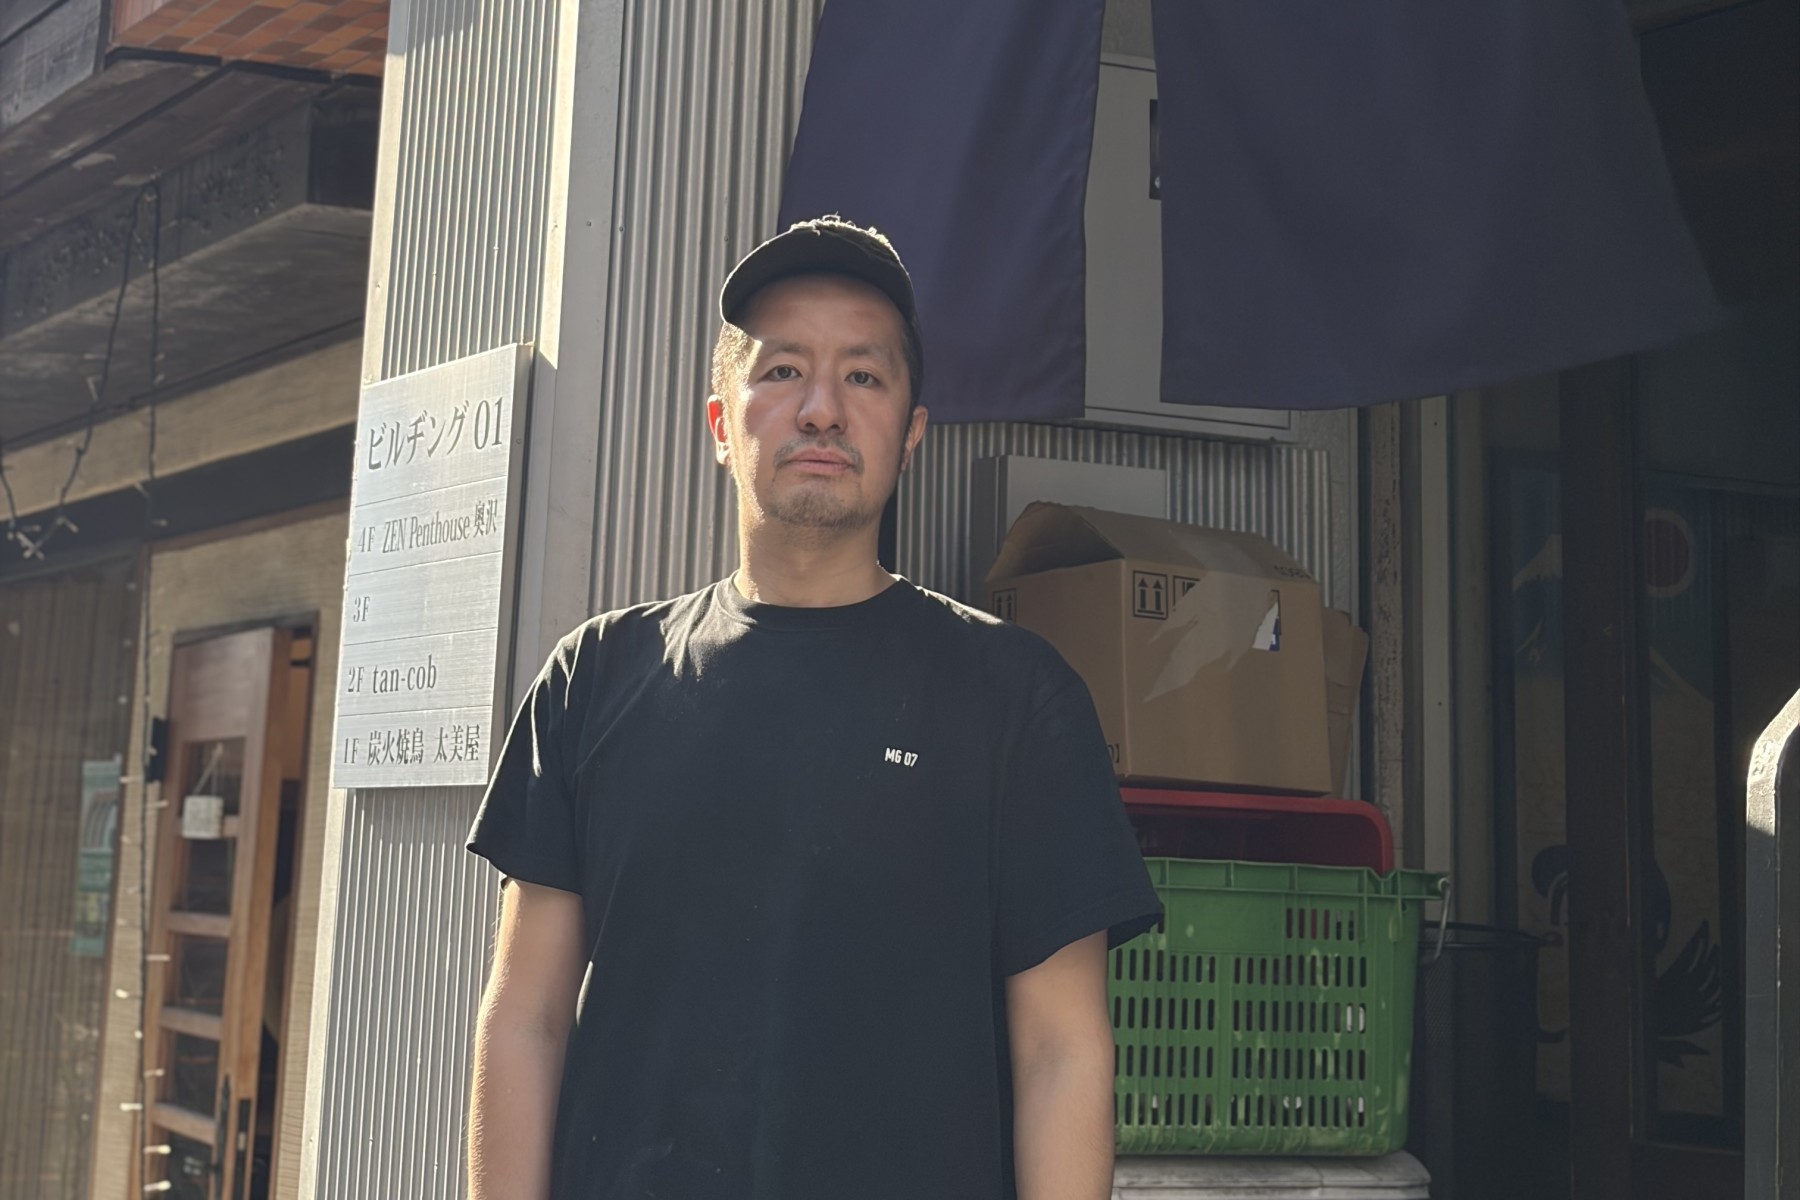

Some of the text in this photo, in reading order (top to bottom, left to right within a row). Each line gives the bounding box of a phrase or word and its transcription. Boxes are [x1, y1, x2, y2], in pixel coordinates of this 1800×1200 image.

[357, 526, 376, 553] 4F
[382, 516, 408, 554] ZEN
[408, 511, 471, 549] Penthouse
[353, 596, 371, 623] 3F
[347, 654, 438, 694] 2F tan-cob
[343, 723, 481, 767] 1F 炭火焼鳥 太美屋
[884, 747, 919, 767] MG 07
